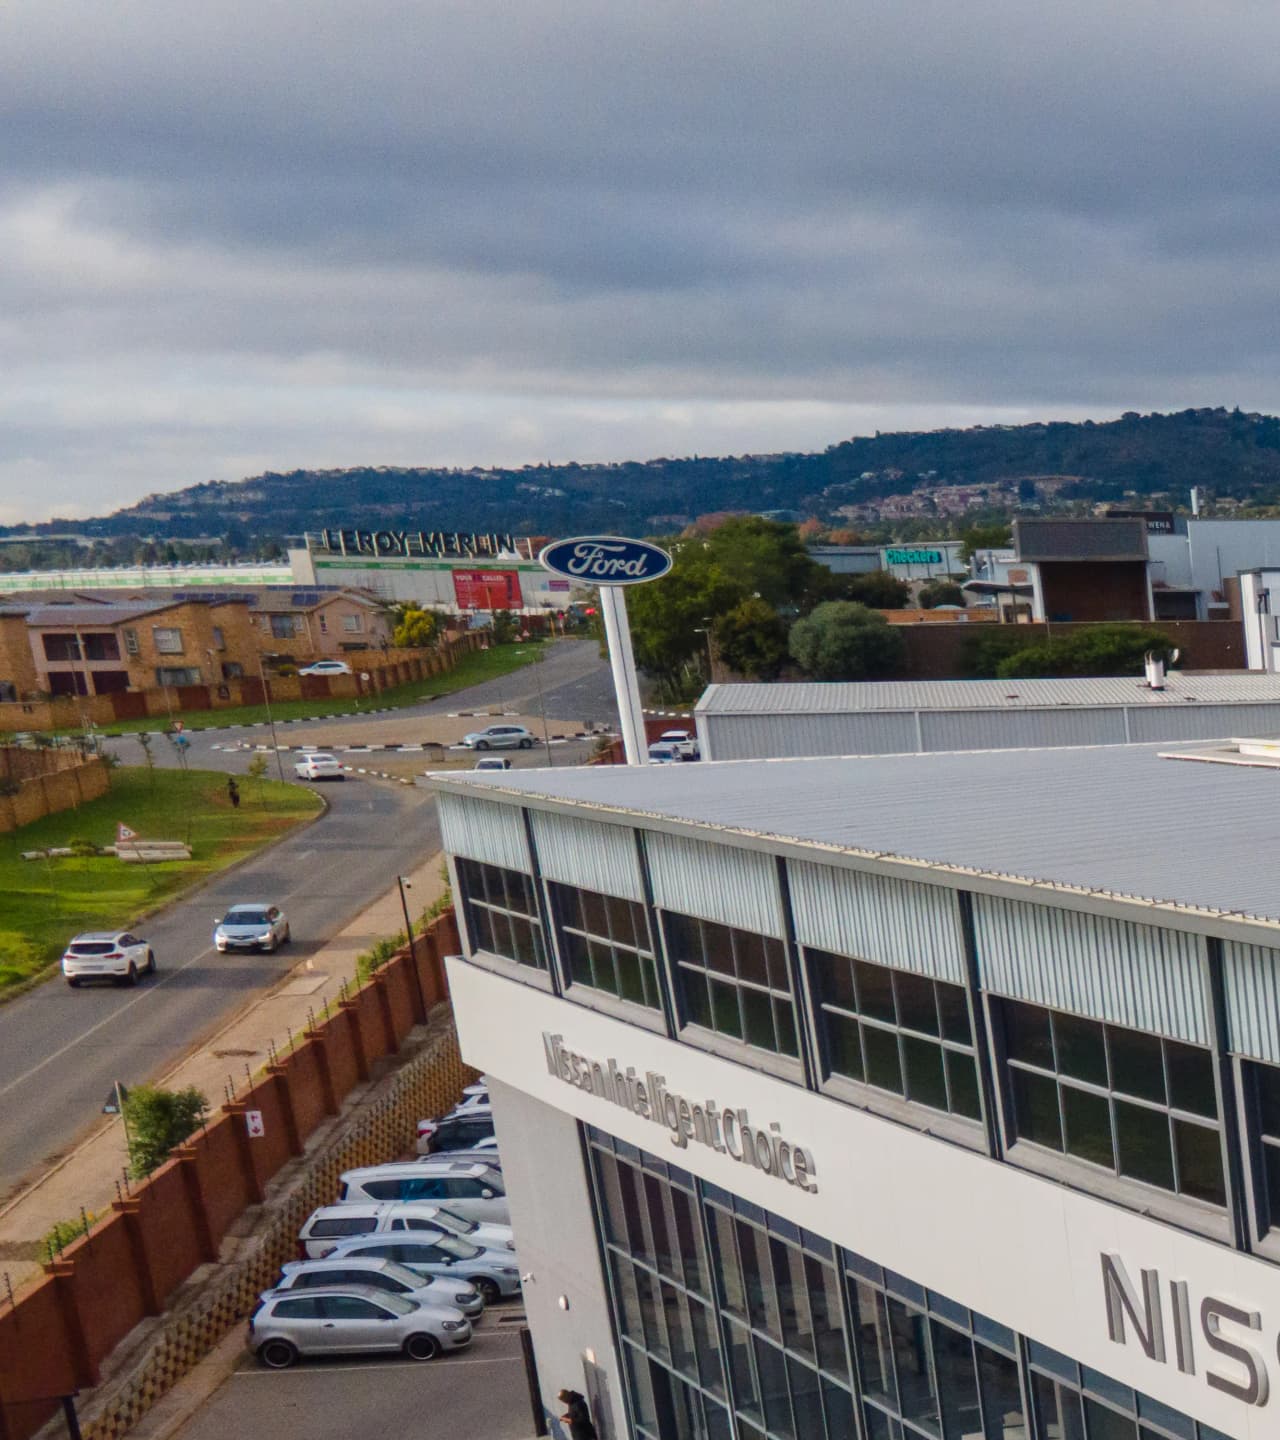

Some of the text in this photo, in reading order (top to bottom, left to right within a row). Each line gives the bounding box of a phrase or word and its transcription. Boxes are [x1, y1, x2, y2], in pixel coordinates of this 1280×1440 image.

[324, 529, 516, 554] LEROY MERLIN
[568, 543, 648, 576] Ford
[886, 549, 942, 564] Checkers
[542, 1031, 819, 1194] Nissan Intelligent Choice
